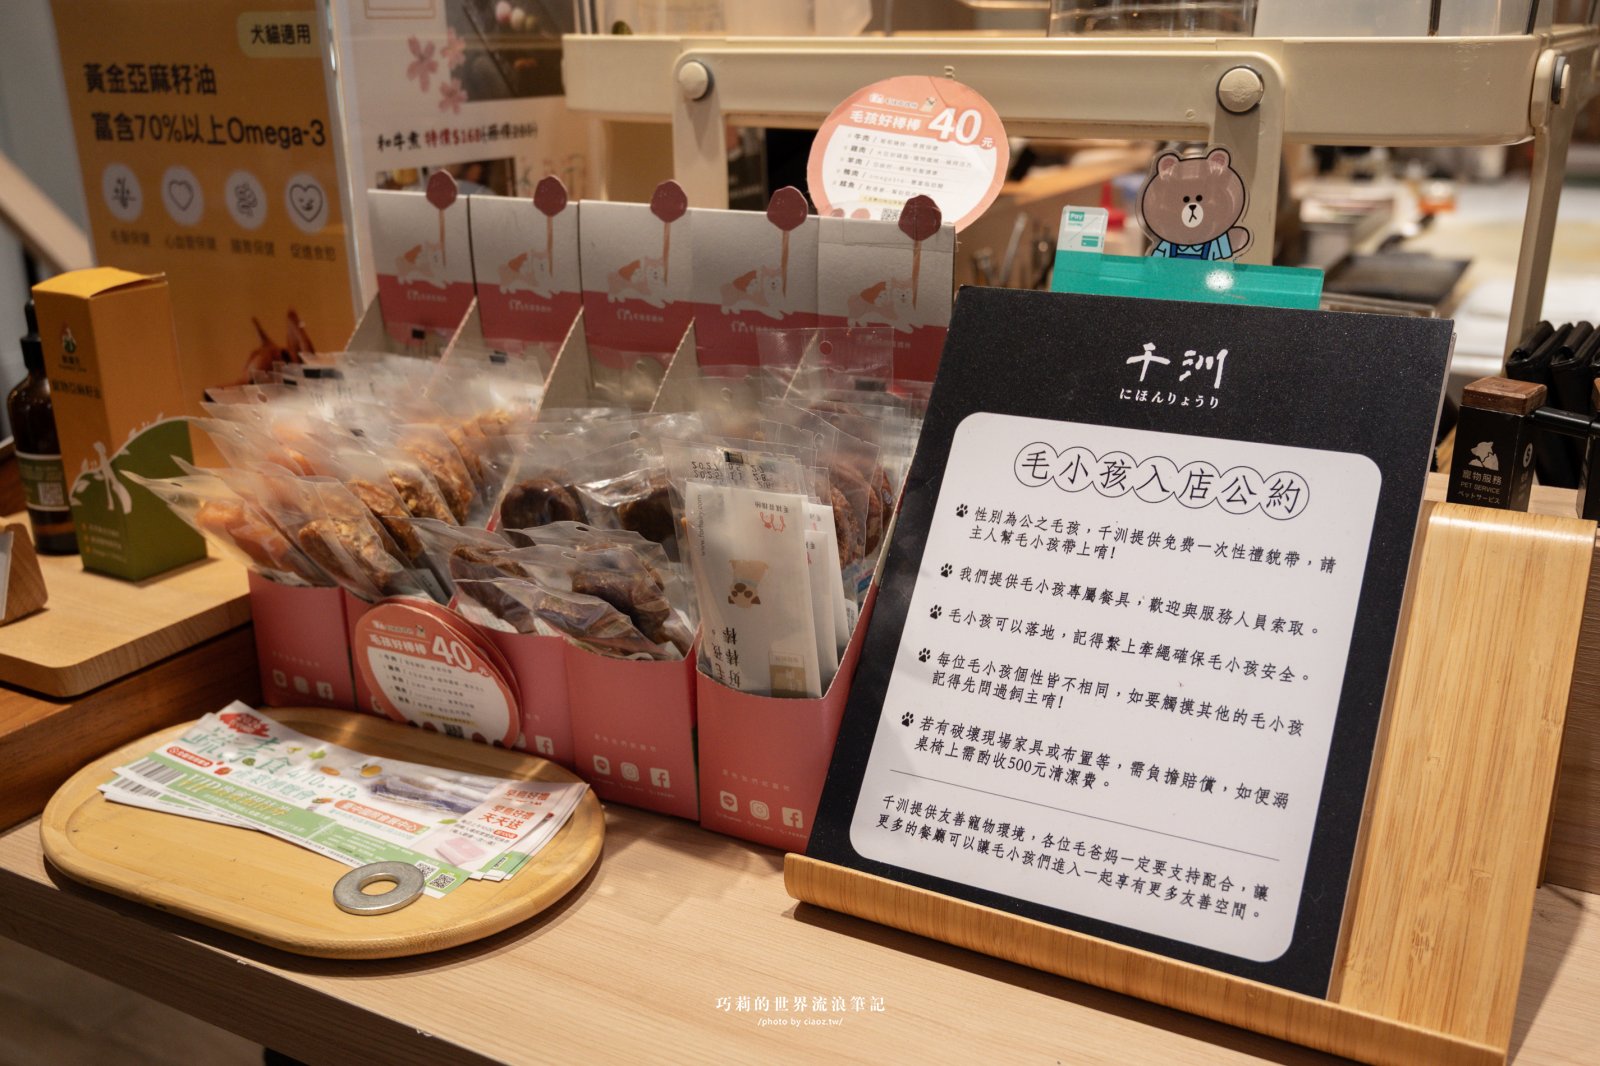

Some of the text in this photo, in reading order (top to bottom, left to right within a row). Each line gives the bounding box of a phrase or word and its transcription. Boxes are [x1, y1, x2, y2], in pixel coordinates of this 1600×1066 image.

[250, 23, 311, 45] 犬貓適用
[83, 63, 217, 95] 黃金亞麻籽油
[91, 112, 326, 150] 富含70%以上Omega-3
[850, 110, 922, 131] 毛孩好棒棒
[927, 107, 994, 149] 40 元
[1119, 387, 1220, 410] にほんりょうり
[1020, 451, 1302, 514] 毛小孩入店公約
[1460, 481, 1501, 495] PET SERVICE
[1462, 469, 1502, 486] 寵物服務
[432, 635, 472, 671] 40
[936, 651, 1305, 737] 每位毛小孩個性皆不相同，如要觸摸其他的毛小孩
[914, 736, 1110, 790] 桌椅上需酌收500元清潔費。
[920, 716, 1289, 810] 若有破壞現場家具或布置等，需負擔賠償，如便溺
